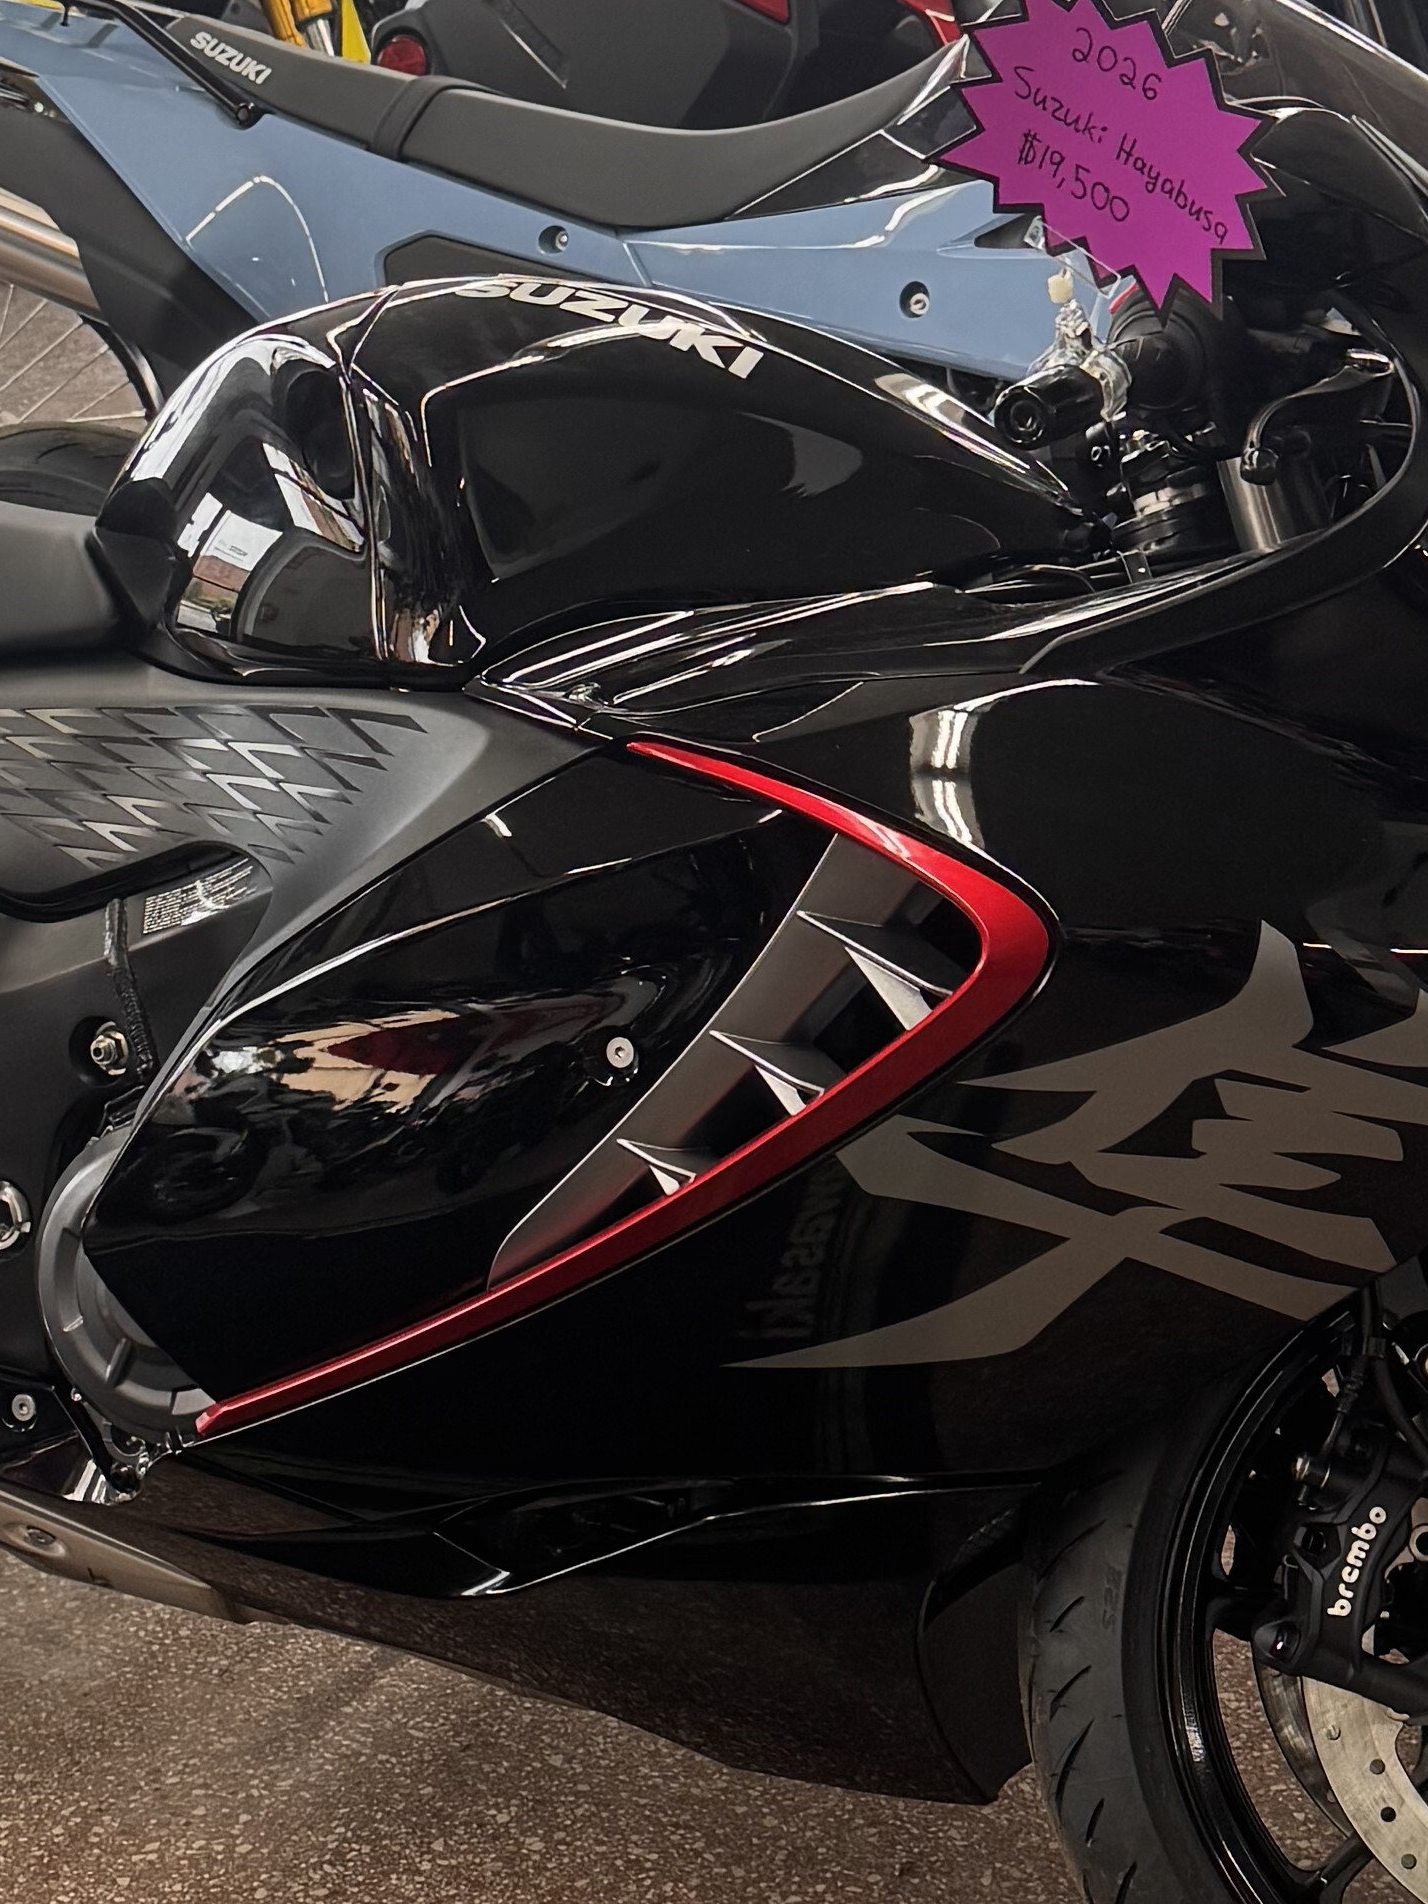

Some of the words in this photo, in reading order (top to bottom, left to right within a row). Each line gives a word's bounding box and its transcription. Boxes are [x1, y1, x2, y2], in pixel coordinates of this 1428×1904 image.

[189, 30, 272, 85] SUZUKI
[1072, 27, 1162, 101] 2026
[1014, 65, 1109, 144] Suzuki
[1115, 132, 1228, 245] Hayabusa
[1018, 129, 1130, 223] $19,500
[455, 278, 764, 380] SUZUKI
[1327, 1506, 1387, 1618] brembo
